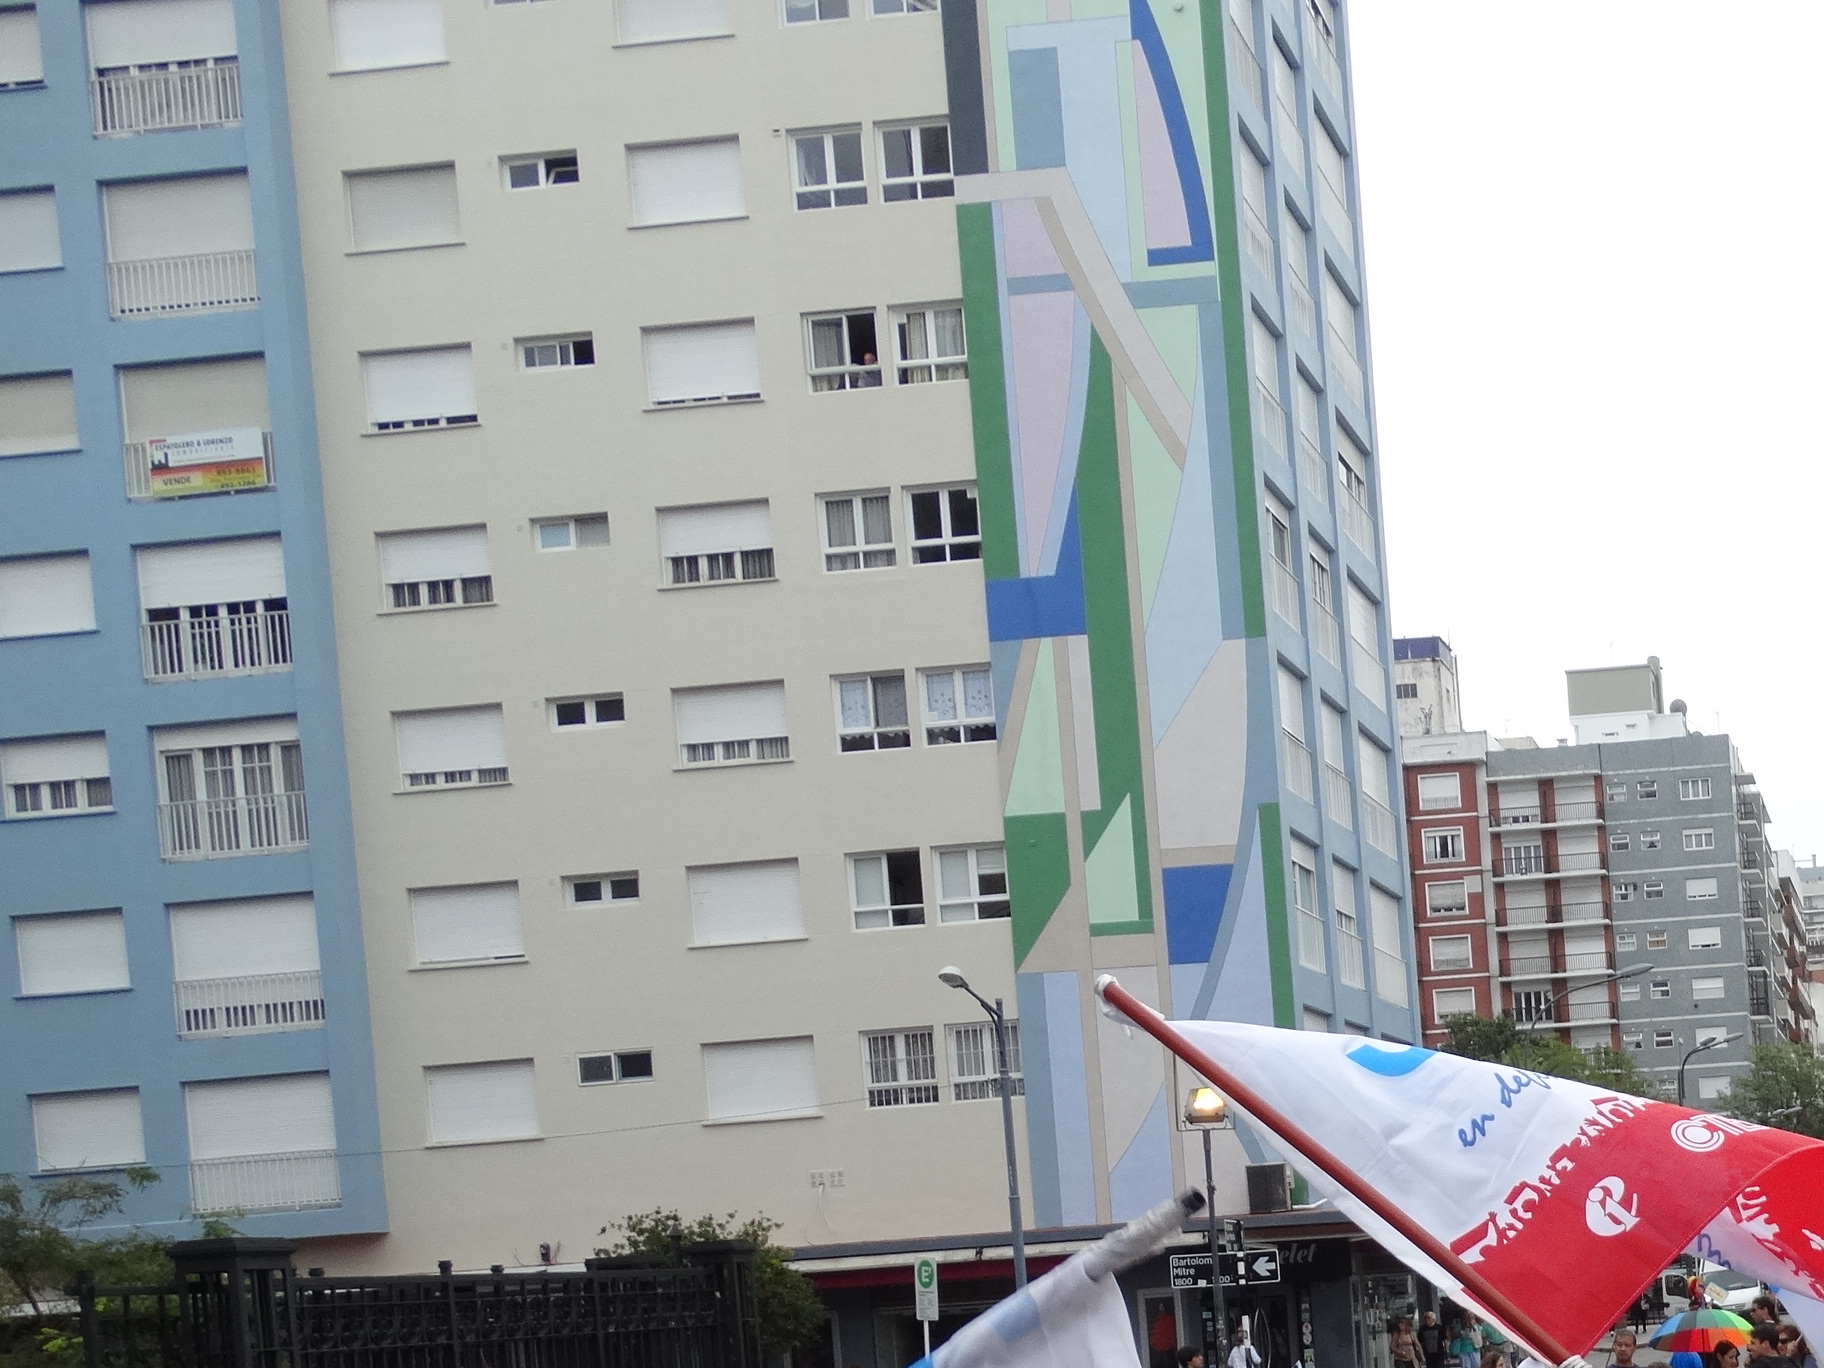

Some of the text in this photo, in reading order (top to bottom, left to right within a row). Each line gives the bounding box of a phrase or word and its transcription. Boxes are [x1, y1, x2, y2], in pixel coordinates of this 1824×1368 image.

[162, 475, 191, 486] VENDE
[1458, 1112, 1496, 1148] en
[1172, 1257, 1213, 1268] Bartolom
[1173, 1267, 1196, 1277] Mitre
[1174, 1275, 1231, 1286] 1800 100
